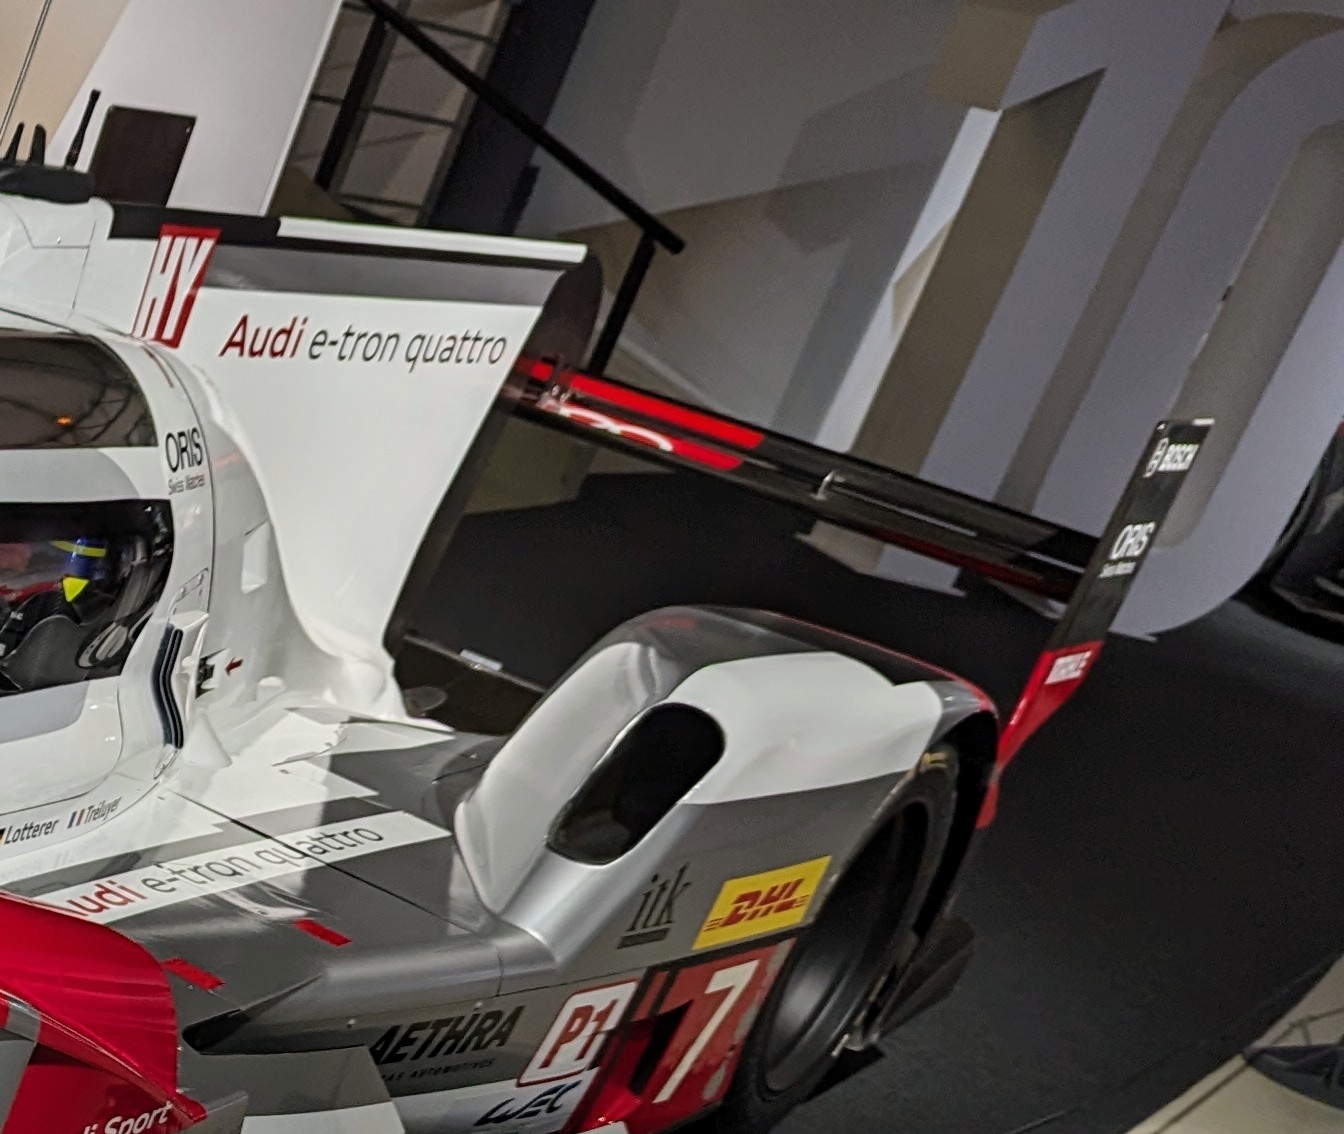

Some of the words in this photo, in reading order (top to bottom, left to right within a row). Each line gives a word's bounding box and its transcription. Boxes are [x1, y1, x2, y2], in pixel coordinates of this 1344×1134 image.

[132, 235, 216, 341] HY
[219, 315, 308, 359] Audi
[308, 324, 401, 363] e-tron
[404, 328, 508, 374] quattro
[165, 426, 204, 473] ORIS
[3, 819, 59, 845] Lotterer
[141, 854, 261, 894] e-tron
[253, 826, 384, 869] quattro
[625, 862, 693, 932] itk
[718, 877, 807, 929] DHL
[369, 1005, 525, 1065] AETHRA
[537, 998, 619, 1069] P1
[651, 959, 760, 1104] 7
